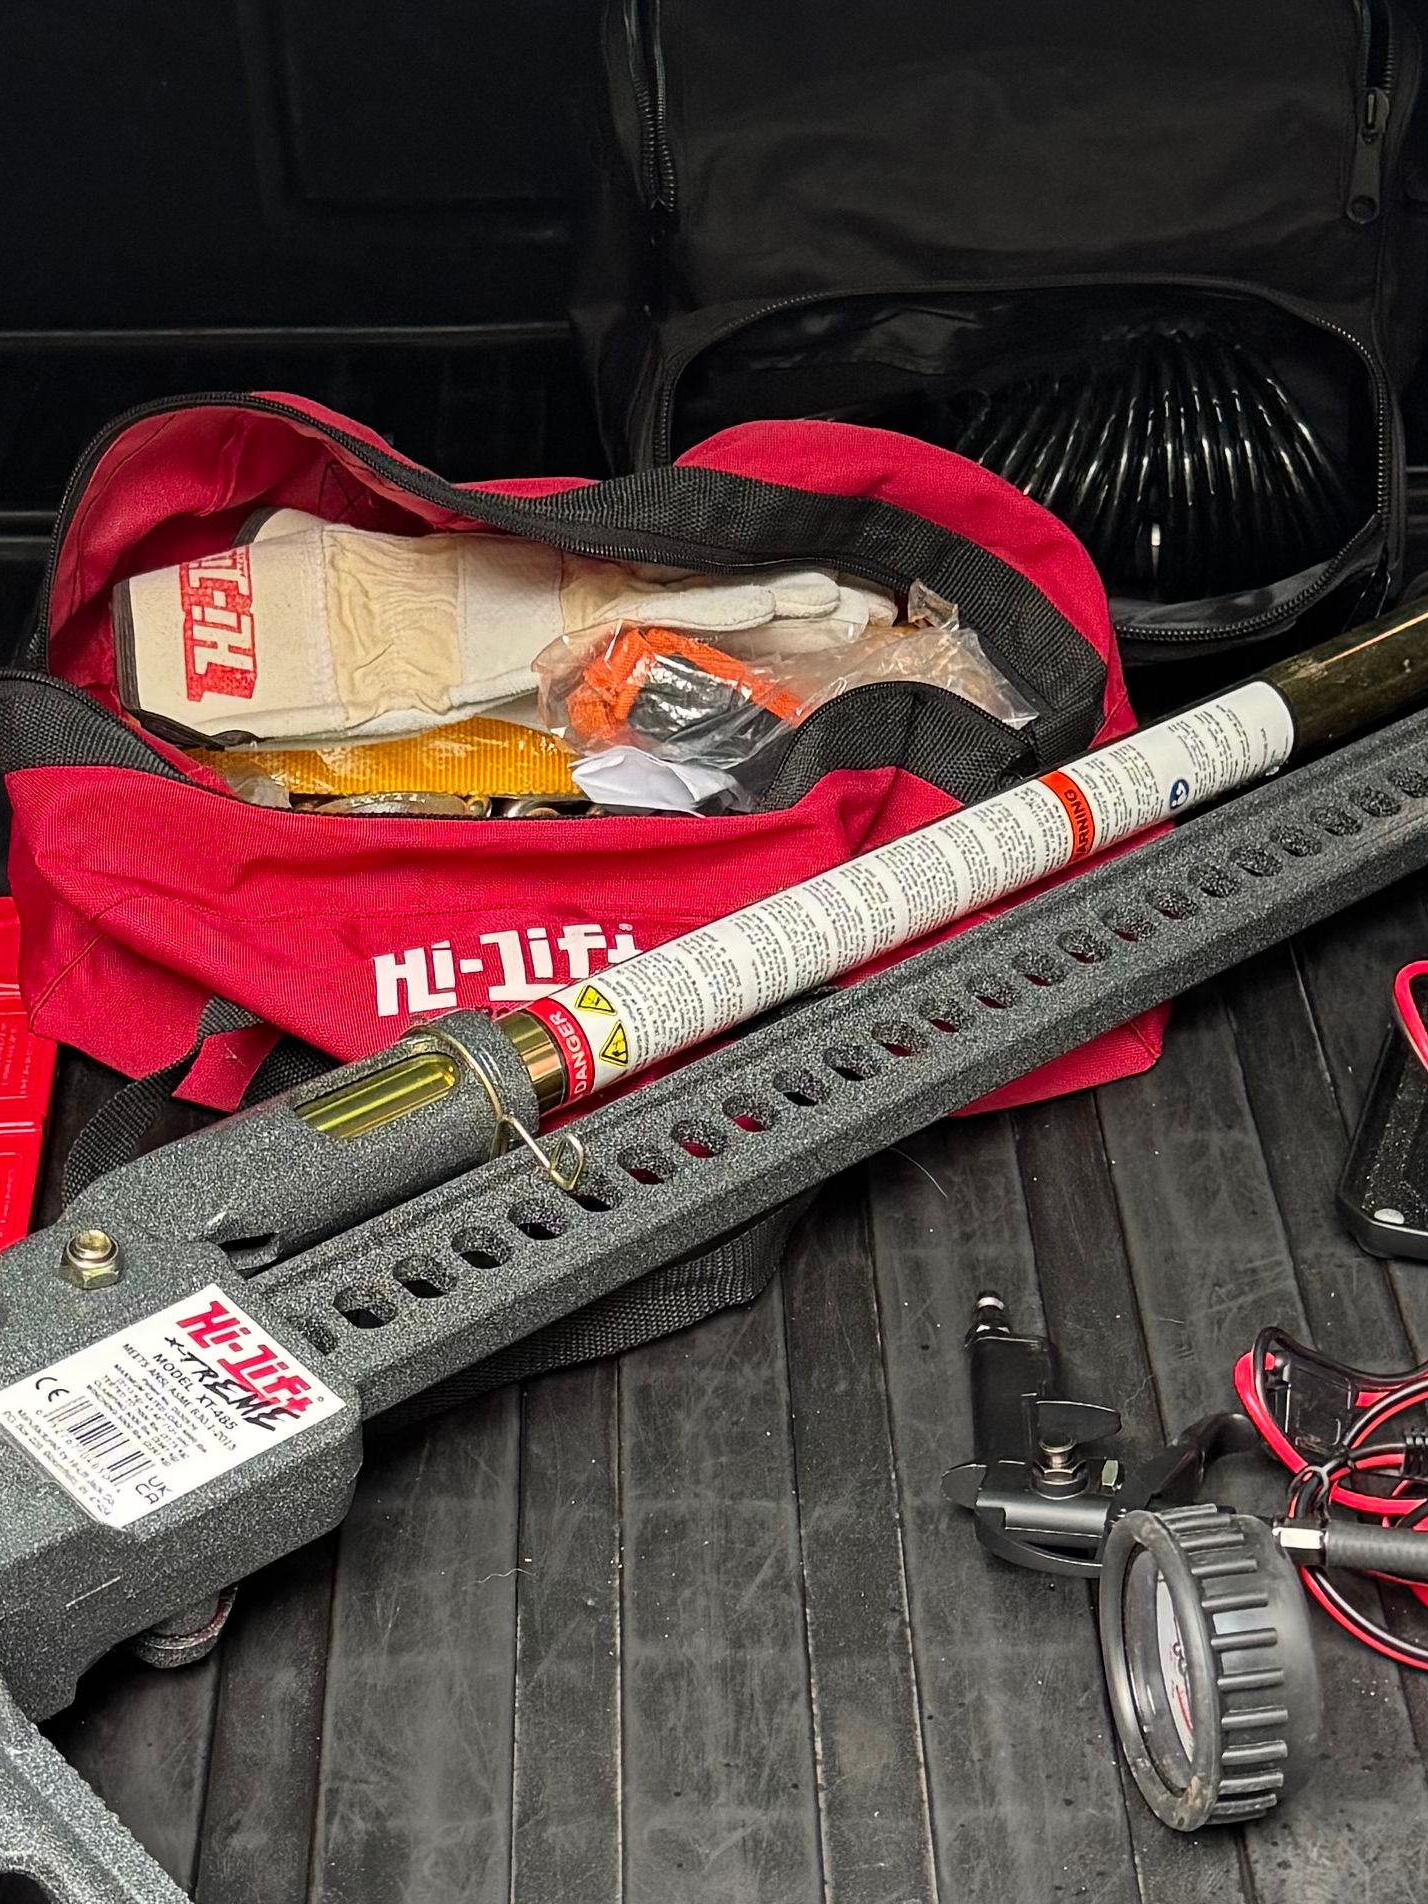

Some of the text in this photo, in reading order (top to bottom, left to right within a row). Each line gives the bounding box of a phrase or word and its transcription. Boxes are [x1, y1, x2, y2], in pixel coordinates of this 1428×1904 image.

[1064, 789, 1089, 857] ARNING
[549, 1010, 588, 1095] DANGER
[153, 1354, 194, 1392] MODEL
[197, 1395, 238, 1430] XT-485
[148, 1476, 172, 1497] UK
